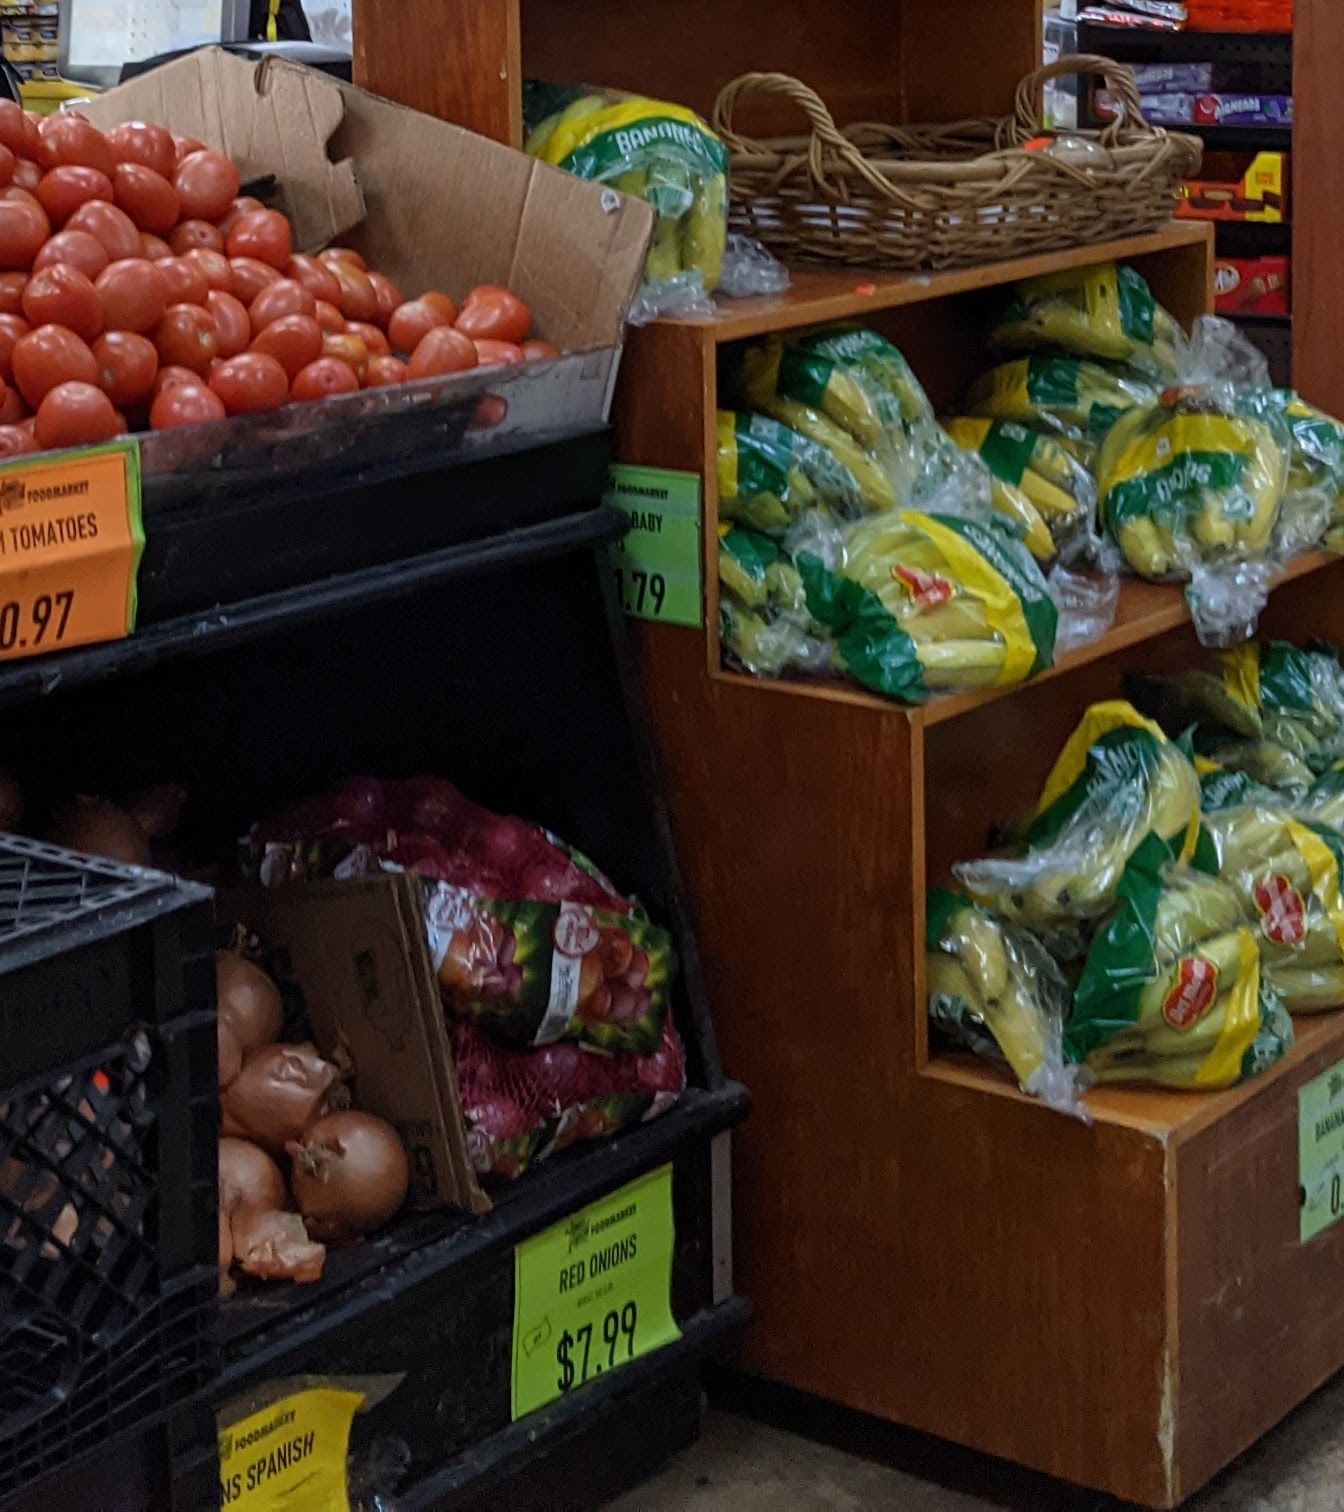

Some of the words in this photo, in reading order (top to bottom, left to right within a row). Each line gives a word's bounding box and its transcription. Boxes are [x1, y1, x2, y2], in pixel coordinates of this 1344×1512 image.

[27, 479, 89, 505] FOODMARKET
[10, 512, 98, 552] TOMATOES
[559, 1260, 586, 1295] RED
[589, 1234, 637, 1278] ONIONS
[557, 1300, 637, 1393] $7.99
[246, 1430, 316, 1493] SPANISH
